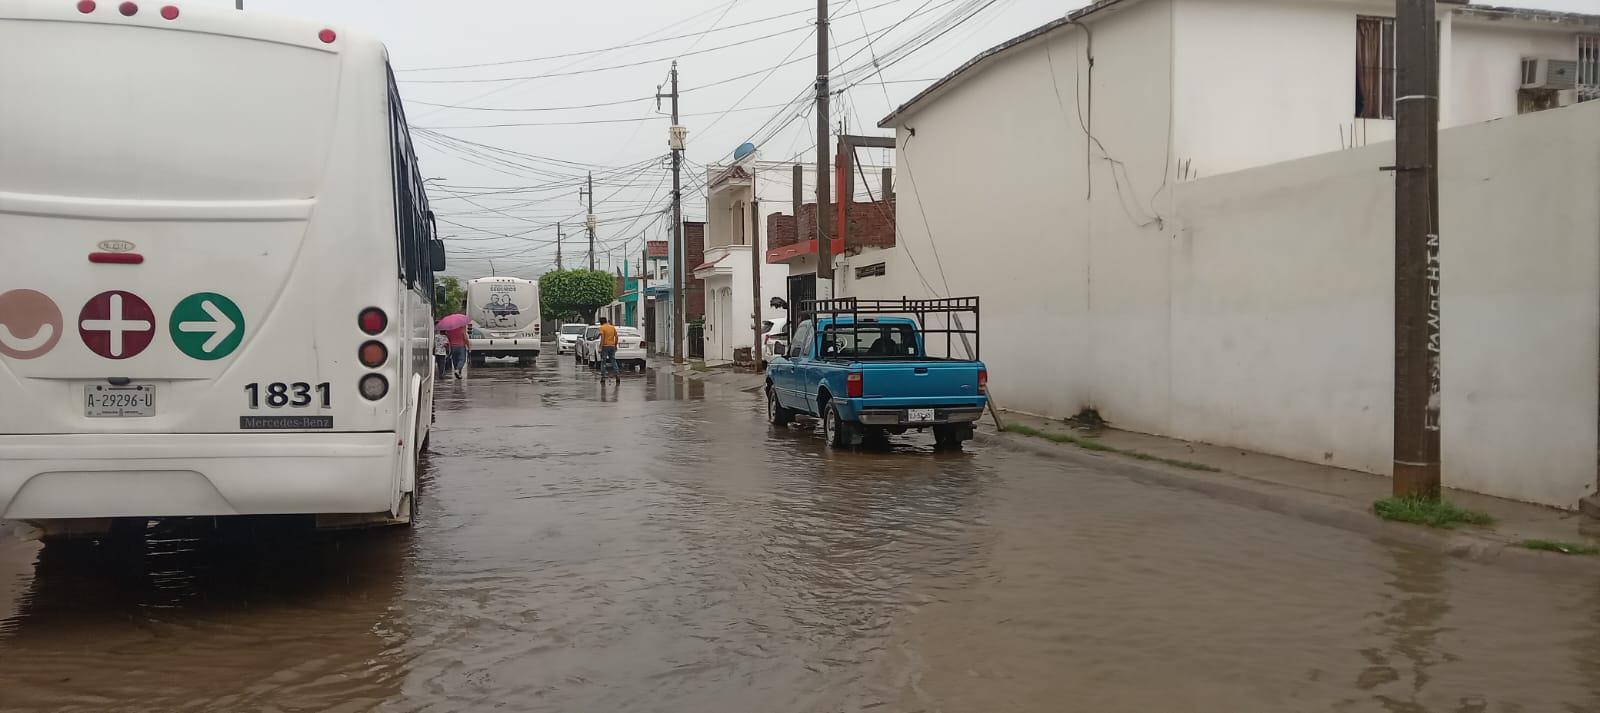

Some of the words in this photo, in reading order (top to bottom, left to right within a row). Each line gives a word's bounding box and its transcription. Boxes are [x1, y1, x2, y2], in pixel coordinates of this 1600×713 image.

[88, 394, 152, 407] A-29296-U
[244, 382, 331, 409] 1831
[245, 417, 329, 428] Mercedes-Benz
